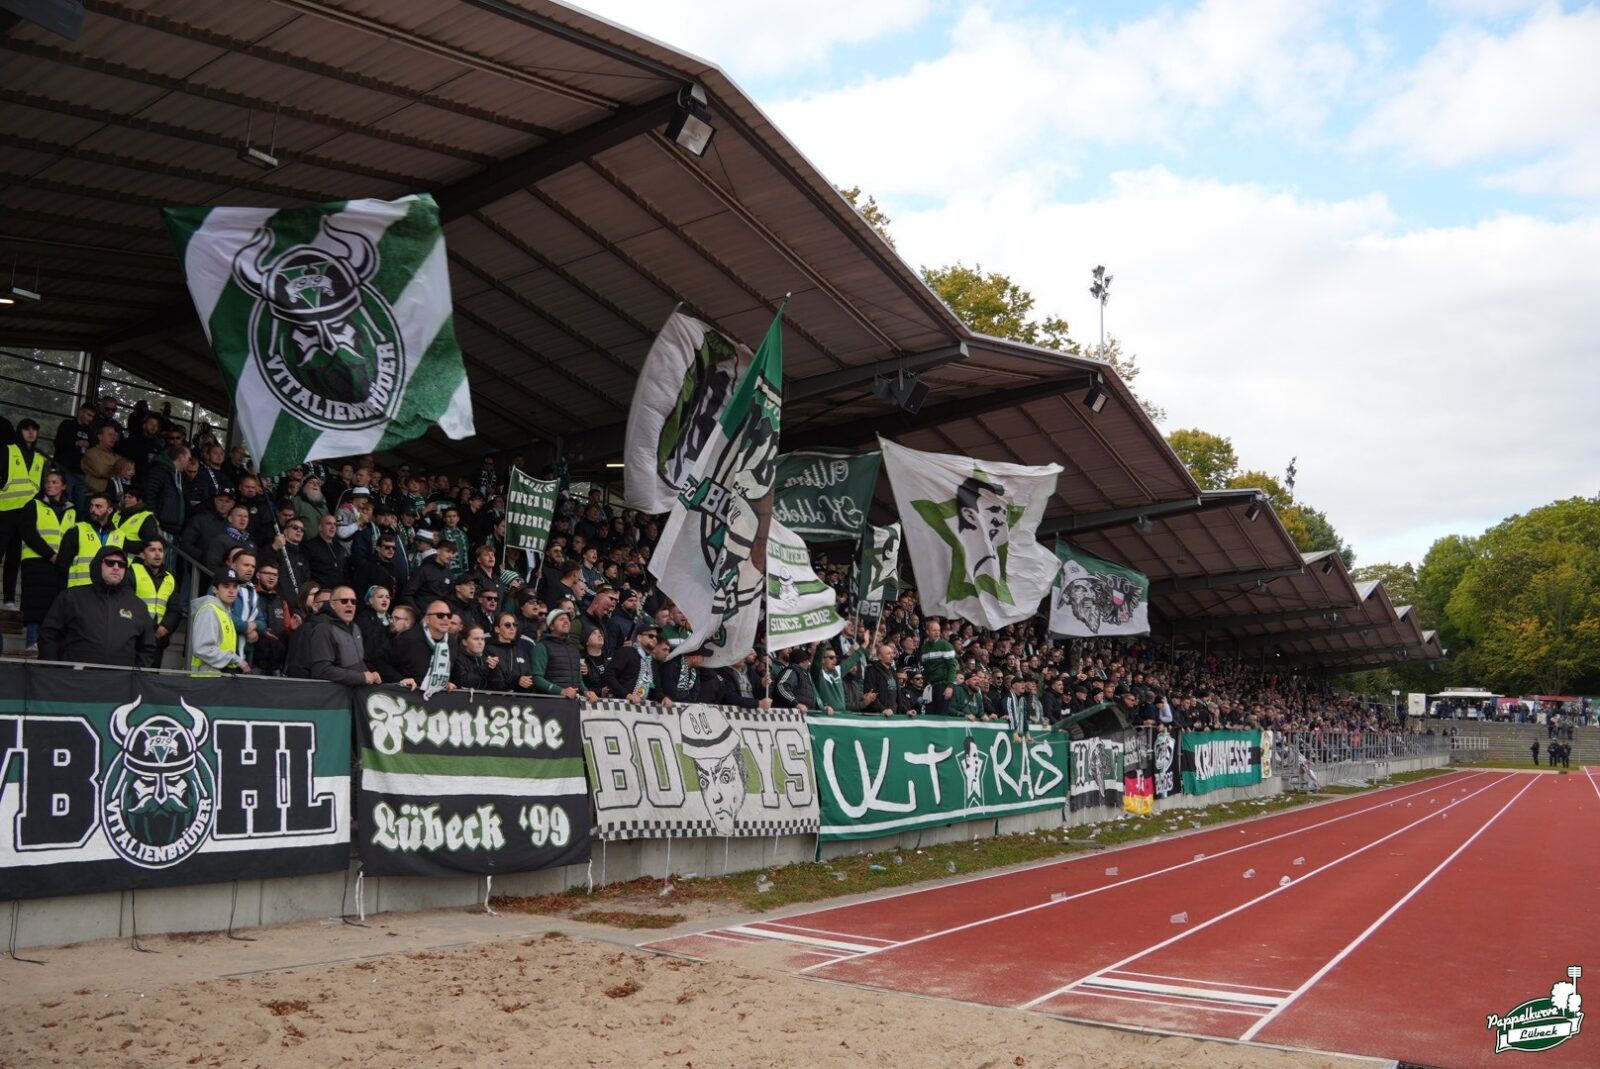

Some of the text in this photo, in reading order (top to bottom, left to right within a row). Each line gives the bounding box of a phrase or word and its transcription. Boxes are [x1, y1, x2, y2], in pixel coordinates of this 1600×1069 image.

[86, 533, 95, 542] 15
[770, 615, 802, 632] SINCE
[150, 736, 173, 747] 1919
[366, 693, 564, 755] Frontside
[213, 719, 337, 841] HL
[106, 798, 212, 862] VITALIENBRÜDER
[372, 801, 506, 851] Lübeck
